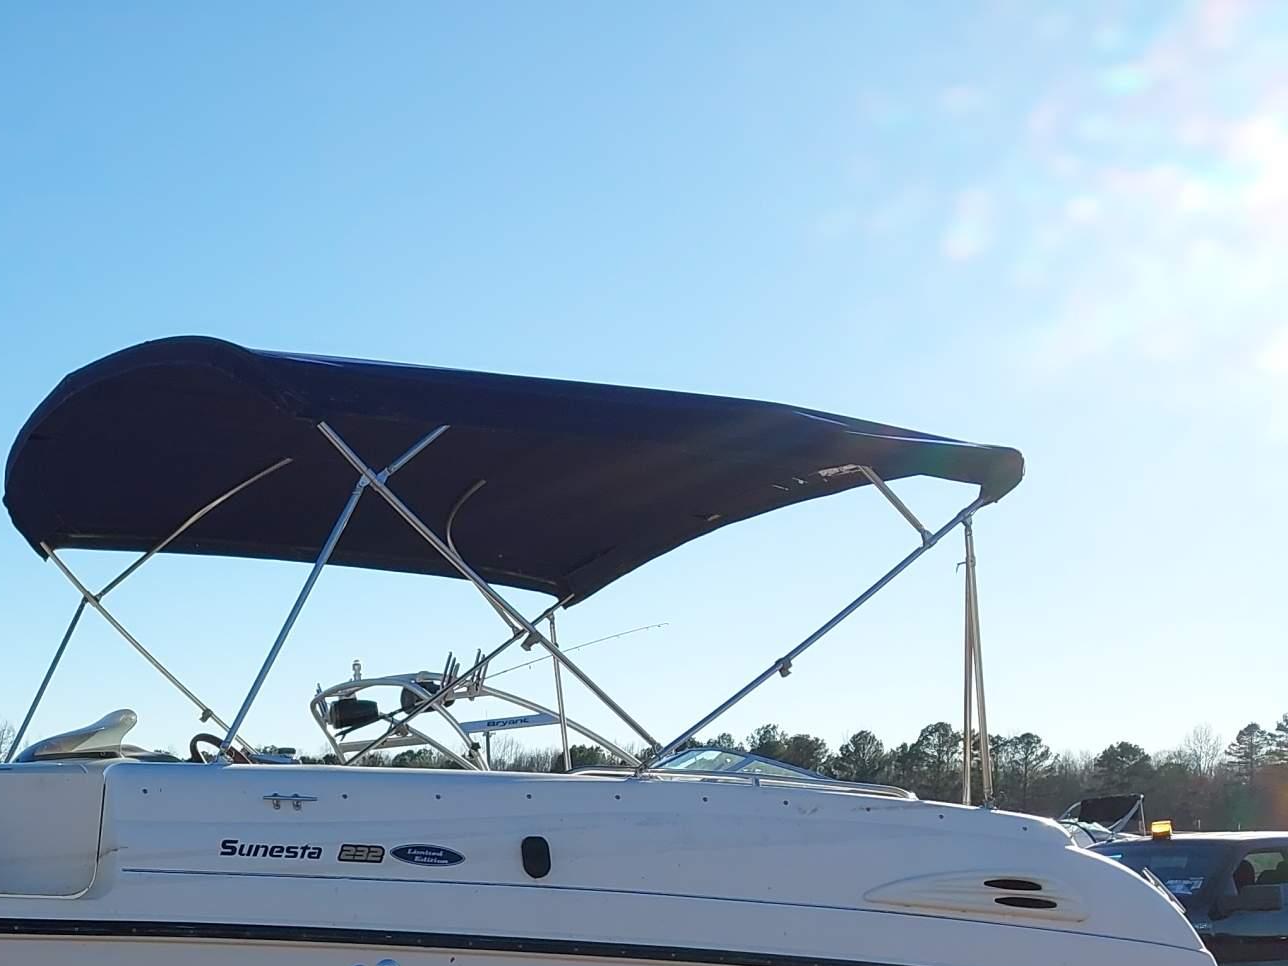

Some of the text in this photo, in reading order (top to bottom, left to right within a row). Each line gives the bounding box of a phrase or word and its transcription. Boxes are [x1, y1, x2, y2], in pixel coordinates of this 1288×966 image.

[487, 718, 529, 727] Bryant
[220, 839, 385, 862] Sunesta 232
